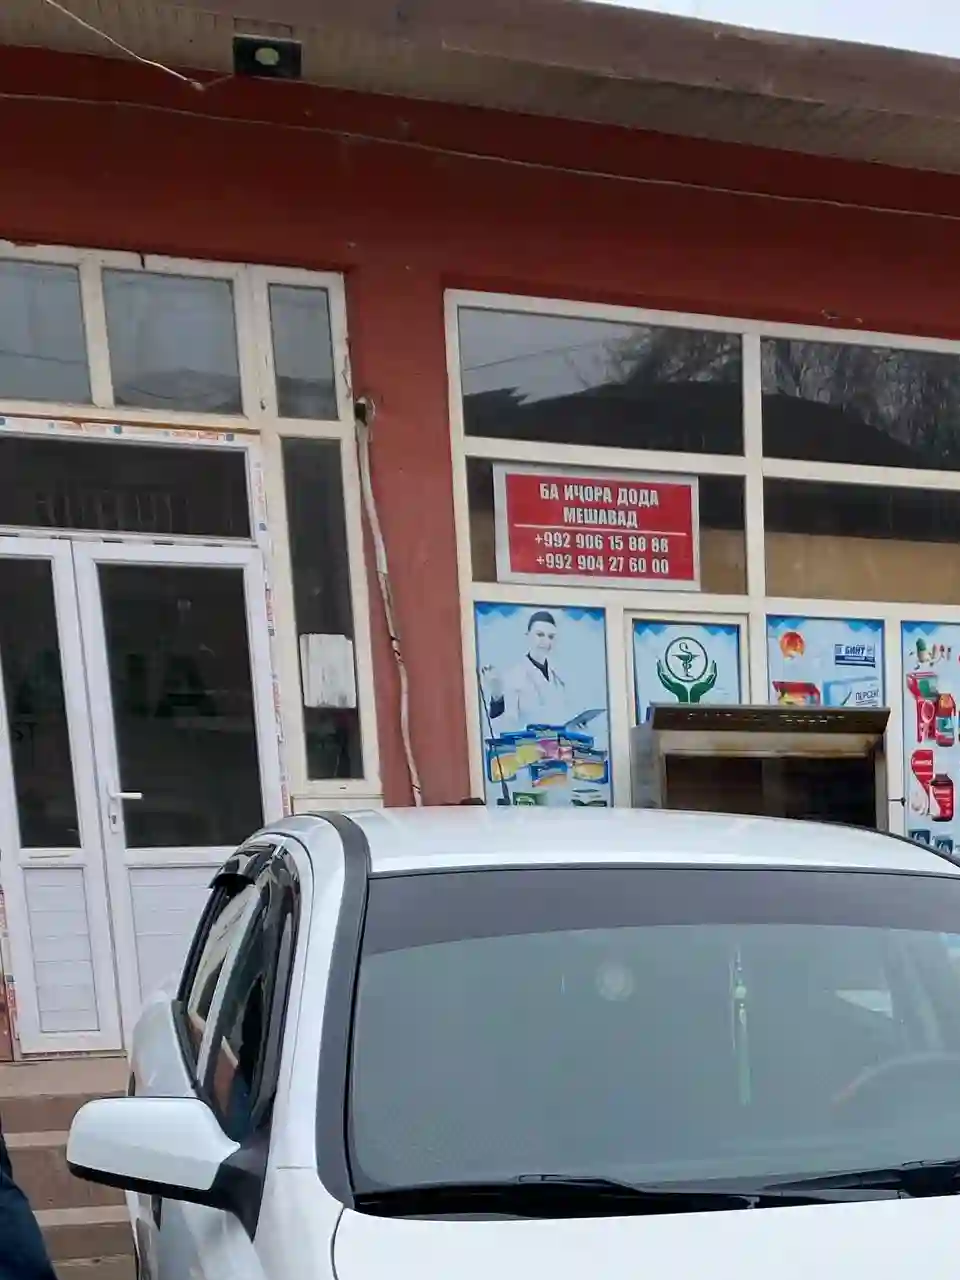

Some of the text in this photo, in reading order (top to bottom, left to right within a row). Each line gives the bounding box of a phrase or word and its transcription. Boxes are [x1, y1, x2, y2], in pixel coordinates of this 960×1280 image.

[540, 483, 559, 500] БА
[617, 488, 659, 507] ДОДА
[563, 507, 638, 529] МЕШАВАД
[535, 532, 571, 548] +992
[575, 534, 604, 550] 906
[608, 536, 624, 550] 15
[536, 553, 669, 574] +992 904 27 60 00
